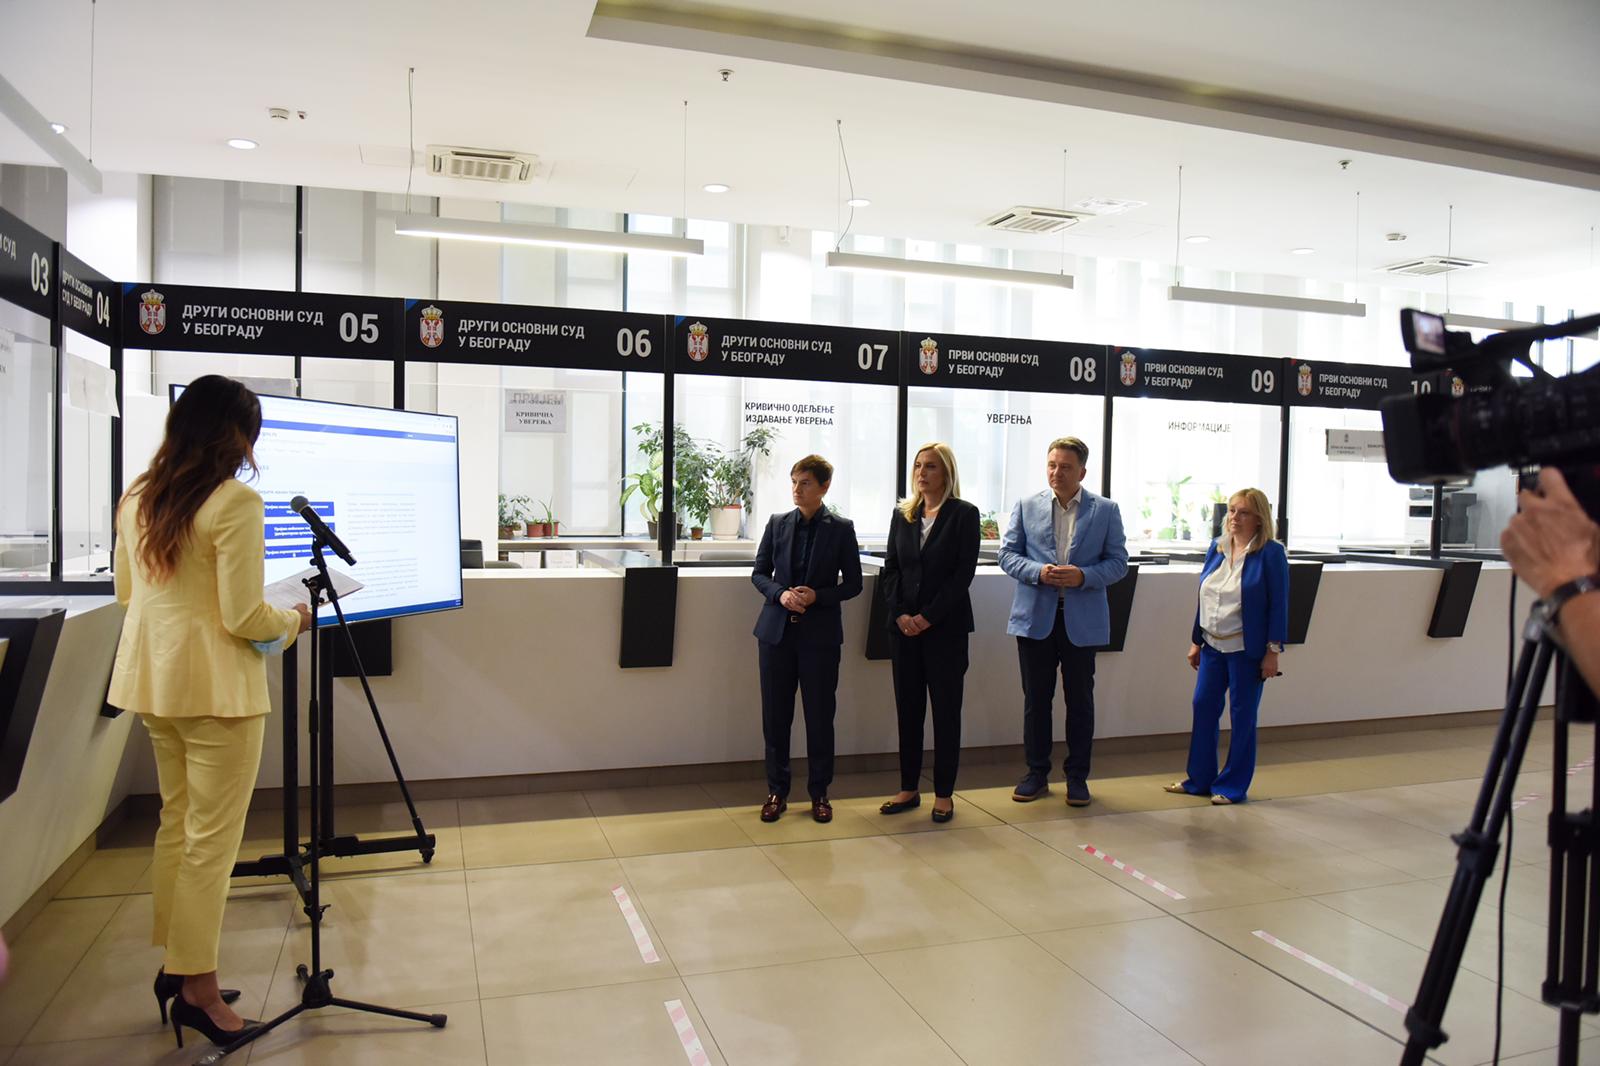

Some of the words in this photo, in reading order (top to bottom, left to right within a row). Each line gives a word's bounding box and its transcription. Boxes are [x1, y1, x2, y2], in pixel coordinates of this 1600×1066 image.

[3, 236, 17, 260] СУД
[31, 252, 49, 296] 03
[97, 291, 110, 327] 04
[182, 305, 227, 319] ДРУГИ
[231, 307, 294, 321] ОСНОВНИ
[297, 311, 324, 326] СУД
[182, 322, 191, 334] У
[195, 323, 263, 339] БЕОГРАДУ
[340, 312, 379, 343] 05
[458, 319, 499, 333] ДРУГИ
[502, 322, 558, 335] ОСНОВНИ
[561, 325, 585, 339] СУД
[458, 336, 466, 347] У
[469, 336, 531, 352] БЕОГРАДУ
[617, 328, 651, 357] 06
[721, 335, 757, 348] ДРУГИ
[760, 337, 809, 350] ОСНОВНИ
[811, 340, 832, 354] СУД
[721, 351, 728, 361] У
[731, 351, 785, 366] БЕОГРАДУ
[858, 343, 888, 370] 07
[948, 349, 974, 361] ПРВИ
[976, 351, 1019, 363] ОСНОВНИ
[1021, 354, 1039, 366] СУД
[948, 363, 955, 374] У
[957, 364, 1004, 378] БЕОГРАДУ
[1070, 356, 1096, 382] 08
[1144, 362, 1167, 373] ПРВИ
[1168, 364, 1206, 375] ОСНОВНИ
[1207, 367, 1224, 378] СУД
[1144, 376, 1150, 386] У
[1151, 377, 1193, 389] БЕОГРАДУ
[1251, 369, 1274, 393] 09
[1319, 373, 1339, 383] ПРВИ
[1340, 375, 1372, 386] ОСНОВНИ
[1373, 378, 1388, 388] СУД
[1411, 380, 1431, 395] 10
[1319, 386, 1325, 396] У
[1325, 387, 1361, 399] БЕОГРАДУ
[745, 402, 791, 412] КРИВИЧНО
[792, 404, 834, 414] ОДЕЉЕЊЕ
[745, 414, 792, 425] ИЗДАВАЊЕ
[795, 416, 833, 425] УВЕРЕЊА
[987, 413, 1032, 425] УВЕРЕЊА
[1168, 421, 1231, 433] ИНФОРМАЦИЈЕ
